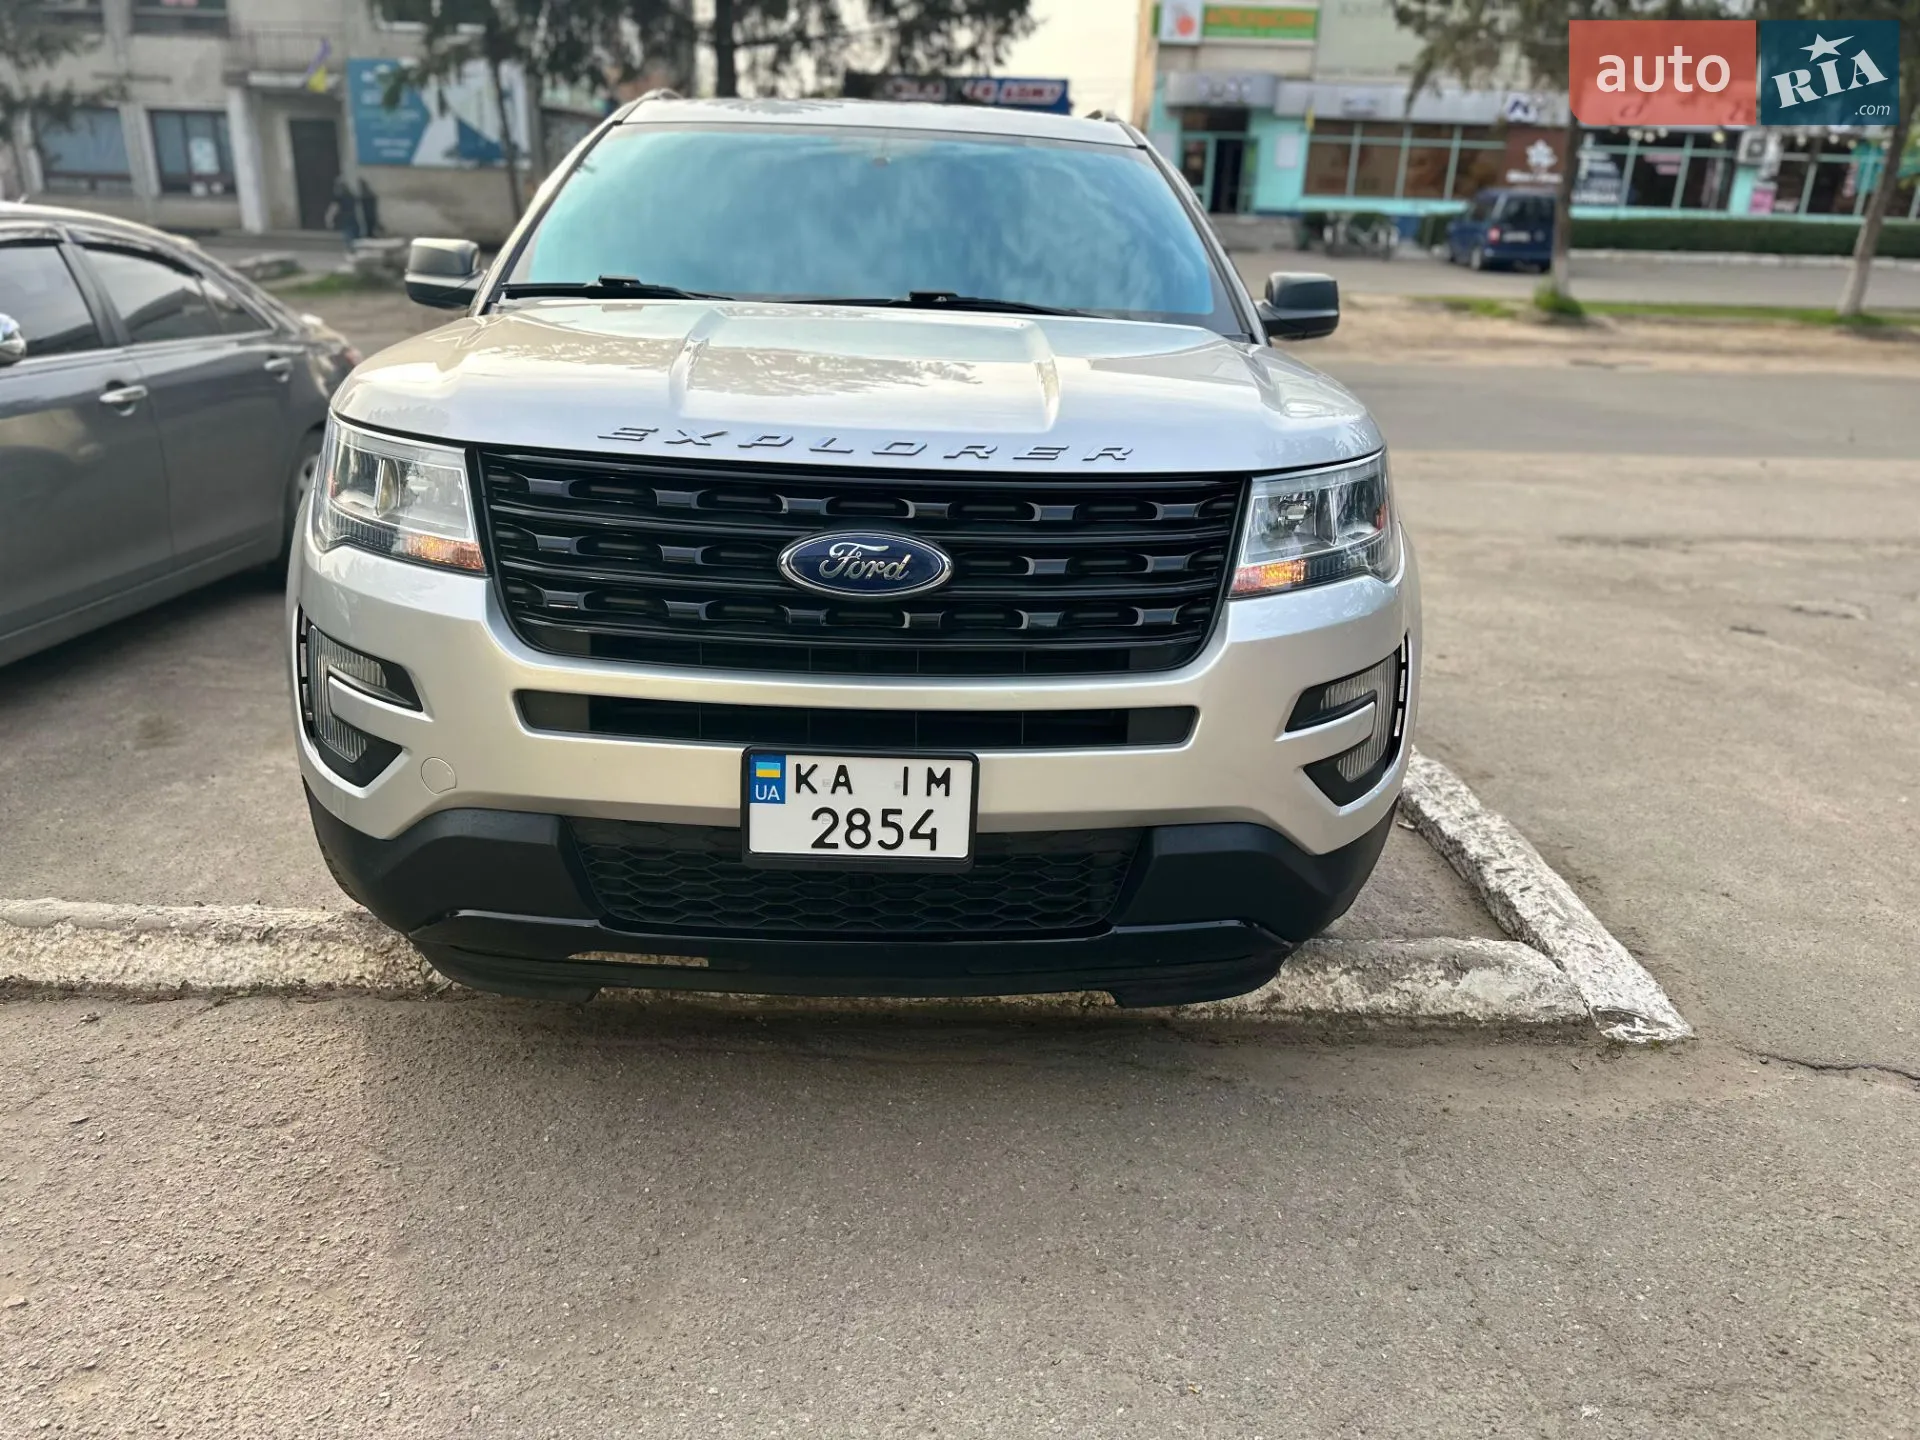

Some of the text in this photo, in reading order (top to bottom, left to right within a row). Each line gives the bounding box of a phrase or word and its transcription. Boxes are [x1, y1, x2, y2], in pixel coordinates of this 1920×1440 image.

[597, 426, 1135, 462] EXPLORER
[818, 541, 911, 581] Ford
[755, 784, 781, 801] UA
[795, 763, 951, 796] KA IM
[810, 806, 937, 851] 2854
